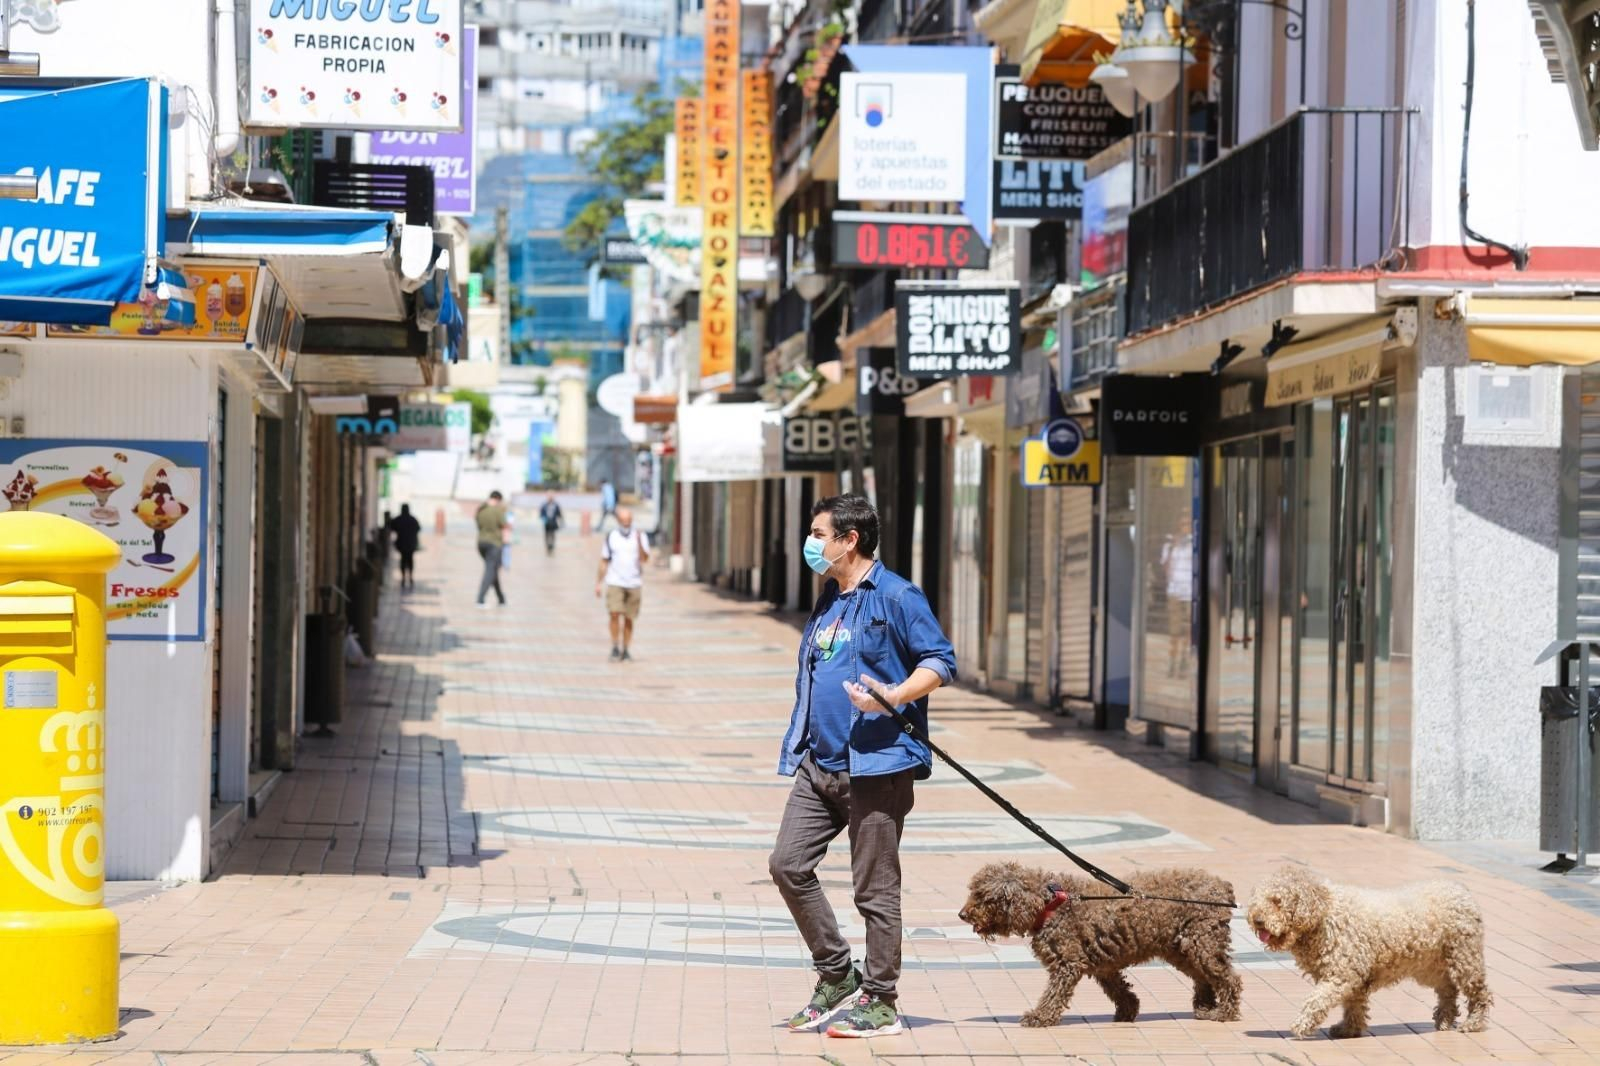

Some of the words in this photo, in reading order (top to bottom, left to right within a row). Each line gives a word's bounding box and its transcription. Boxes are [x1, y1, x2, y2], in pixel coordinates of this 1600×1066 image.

[294, 34, 415, 52] FABRICACION
[323, 57, 386, 73] PROPIA
[1023, 103, 1114, 117] COIFFEUR
[854, 157, 863, 171] y
[871, 156, 949, 171] apuestas
[856, 176, 882, 191] del
[888, 176, 947, 191] estado
[710, 165, 729, 251] TORO
[1001, 192, 1042, 207] MEN
[709, 272, 727, 359] AZUL
[933, 294, 1010, 325] MIGUE
[909, 295, 933, 354] DON
[933, 325, 1010, 353] LITO
[909, 355, 952, 371] MEN
[956, 354, 1011, 370] SHOP
[1038, 463, 1089, 481] ATM
[111, 583, 180, 598] Fresas
[38, 808, 57, 817] 902
[61, 805, 77, 815] 197
